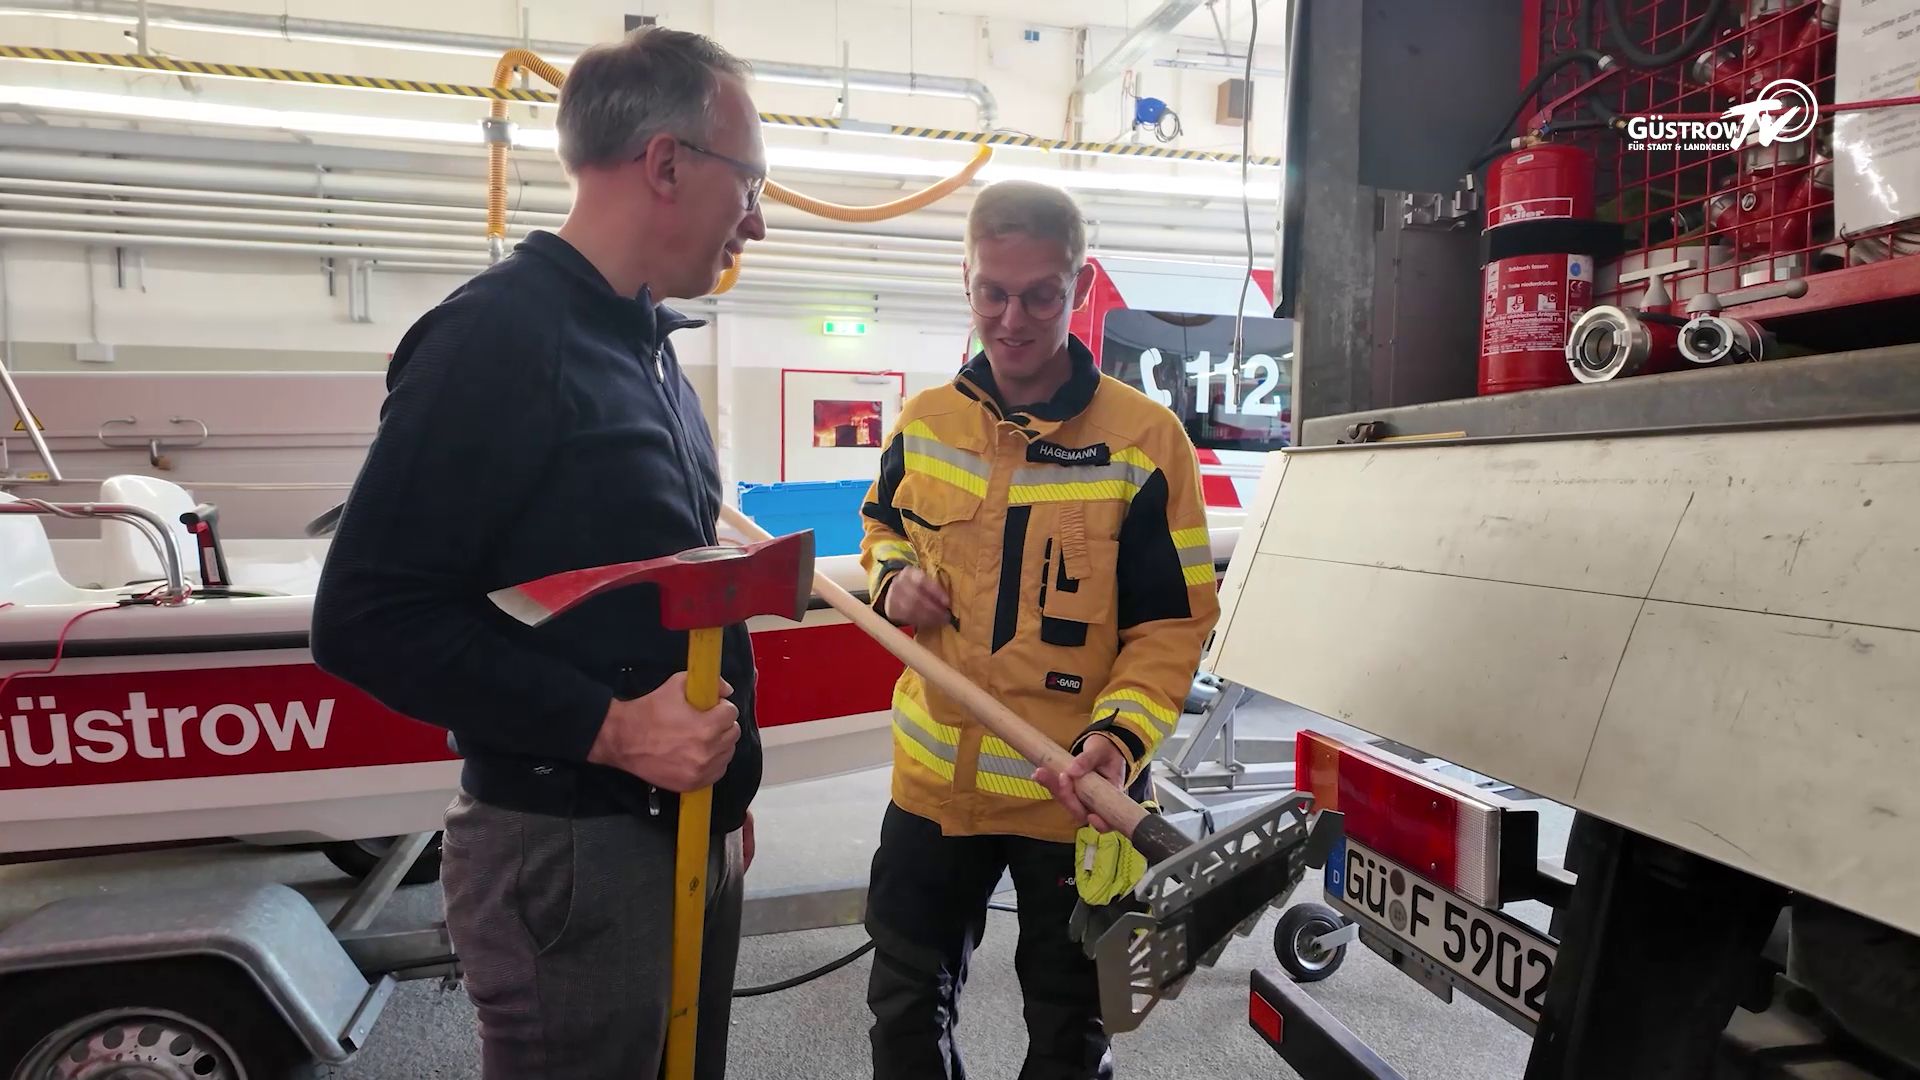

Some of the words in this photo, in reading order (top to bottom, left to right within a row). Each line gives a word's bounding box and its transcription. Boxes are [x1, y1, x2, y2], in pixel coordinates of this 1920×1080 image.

[1503, 206, 1545, 222] Adler
[1517, 295, 1524, 304] B
[1548, 294, 1557, 303] C
[1185, 350, 1282, 417] 112
[1040, 445, 1097, 460] HAGEMANN
[0, 692, 336, 768] üstrow
[1332, 869, 1341, 884] D
[1346, 848, 1387, 918] GÜ
[1410, 884, 1435, 937] F
[1443, 900, 1553, 1014] 5902
